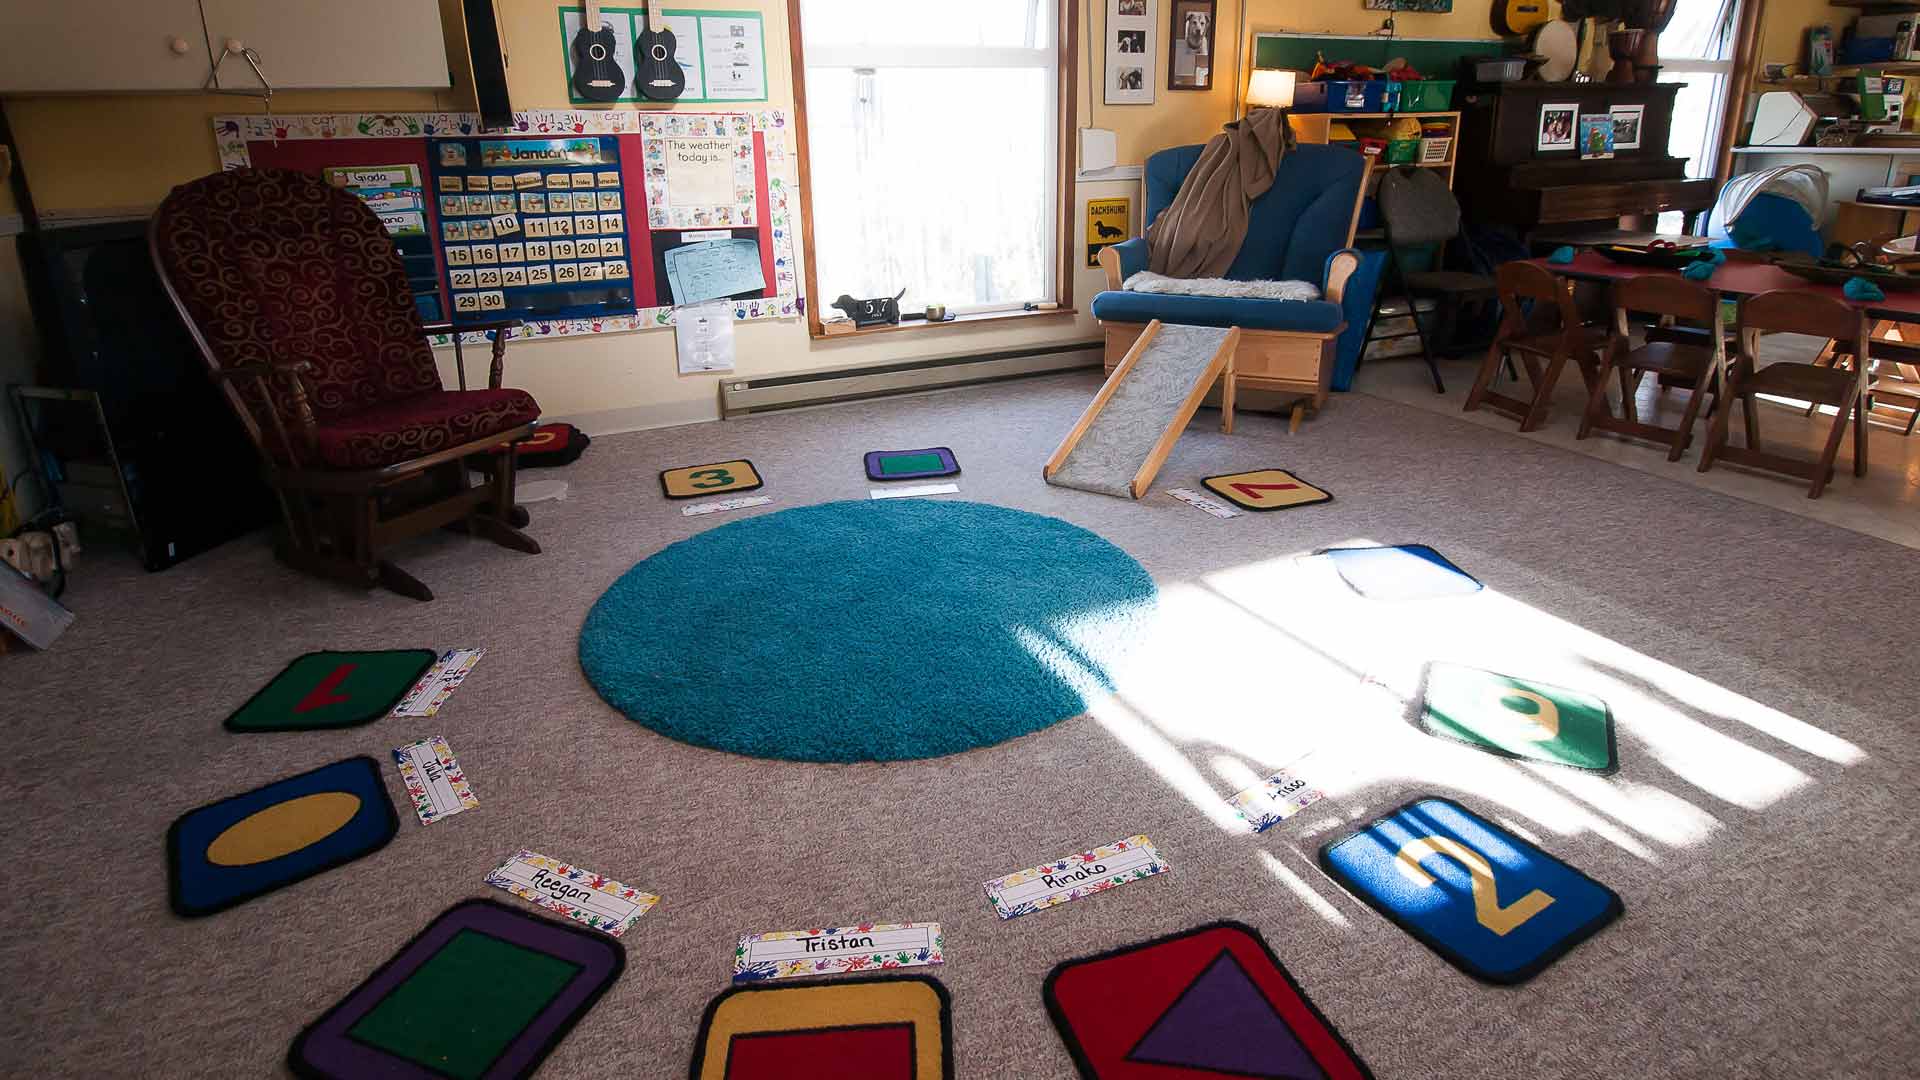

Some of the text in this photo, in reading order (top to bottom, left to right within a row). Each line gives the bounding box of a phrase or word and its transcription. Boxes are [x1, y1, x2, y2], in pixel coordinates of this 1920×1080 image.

[667, 140, 731, 150] The weather
[678, 152, 708, 164] today
[497, 217, 619, 233] 10 11 12 13 14
[450, 241, 619, 261] 15 16 17 18 19 20 21
[454, 263, 624, 285] 22 23 24 25 26 27 28
[459, 294, 500, 308] 29 30
[689, 468, 736, 489] 3
[530, 868, 592, 904] Reegan
[1394, 835, 1556, 937] 2
[796, 935, 875, 953] Tristan
